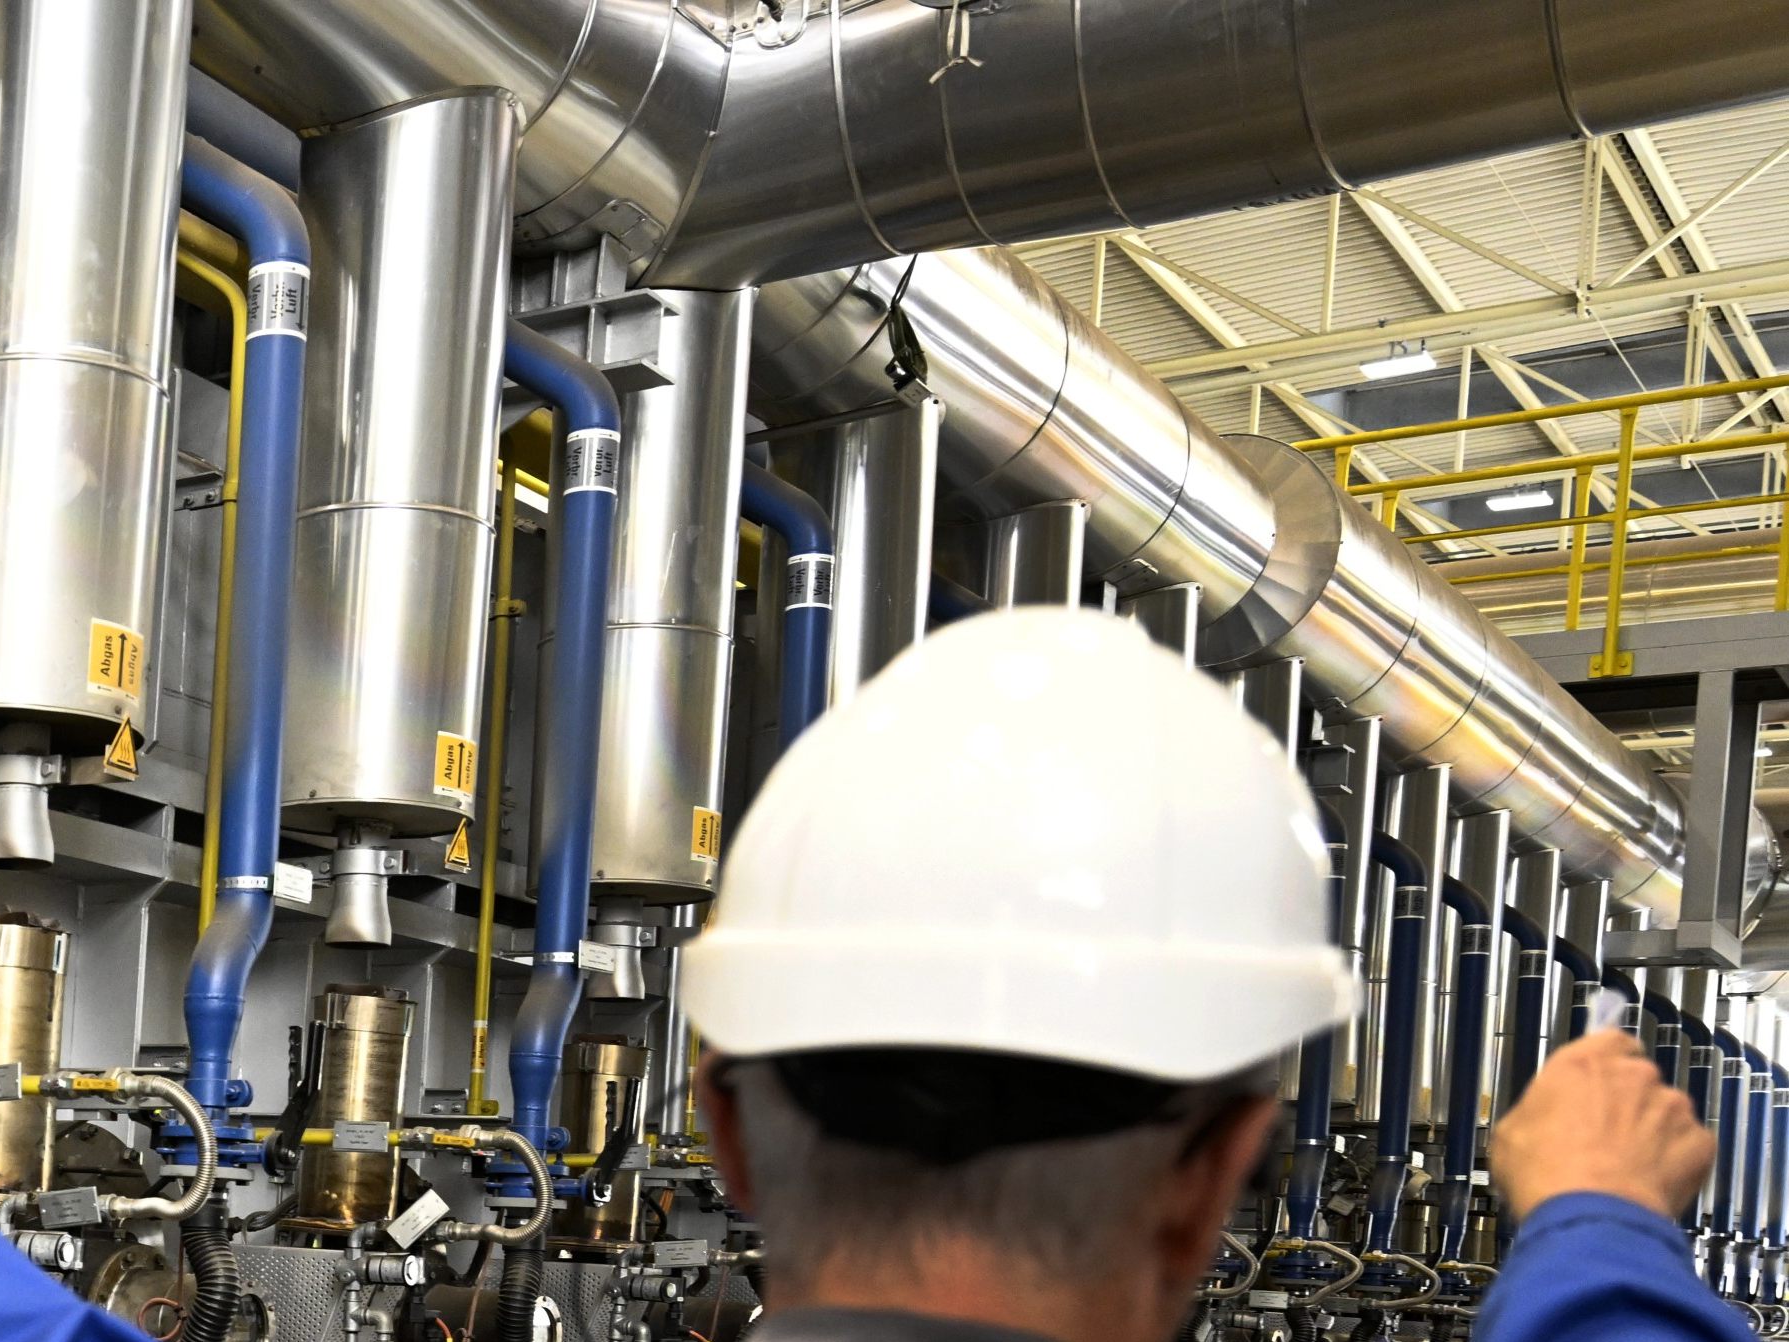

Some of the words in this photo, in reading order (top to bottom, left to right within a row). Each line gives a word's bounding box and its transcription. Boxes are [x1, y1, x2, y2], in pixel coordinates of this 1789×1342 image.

[285, 288, 298, 314] Luft
[100, 635, 114, 678] Abgas
[444, 744, 455, 781] Abgas
[698, 817, 708, 849] Abgas
